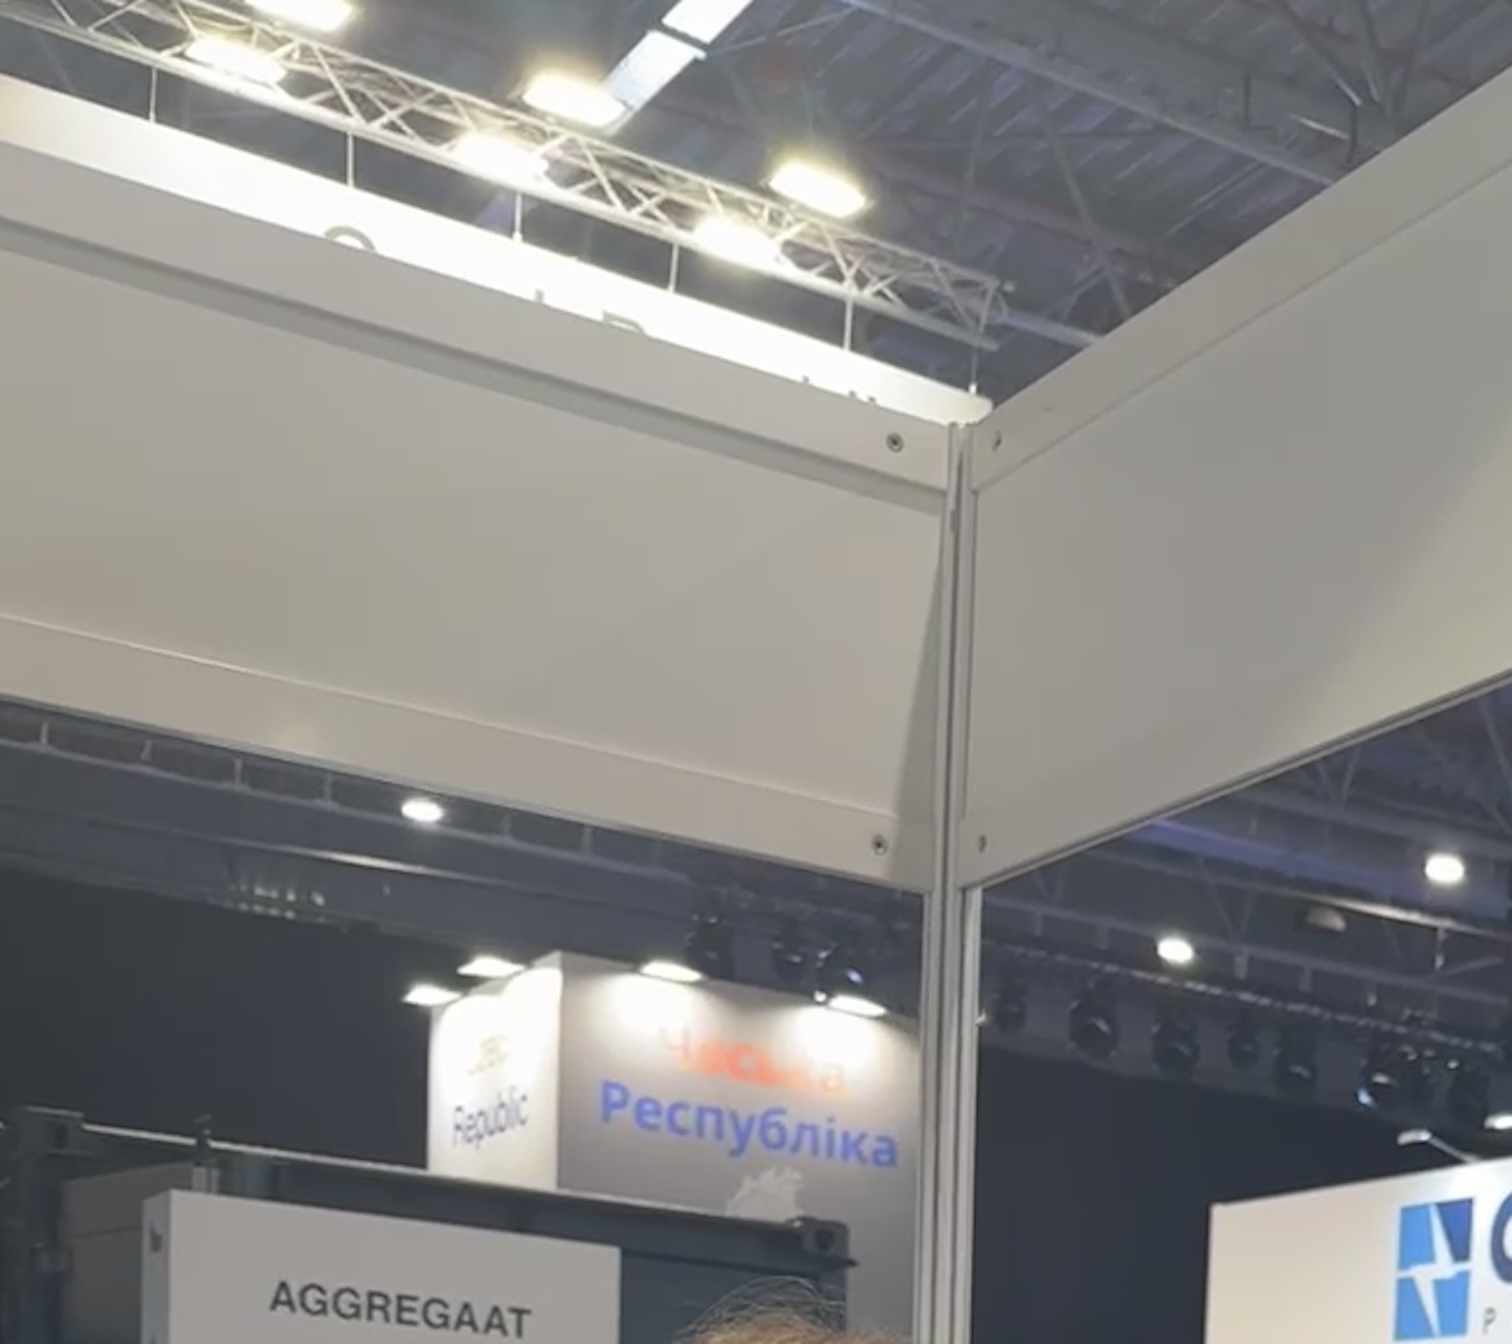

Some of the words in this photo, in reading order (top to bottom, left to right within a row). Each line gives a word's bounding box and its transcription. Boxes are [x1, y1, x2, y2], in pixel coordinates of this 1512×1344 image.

[453, 1082, 529, 1149] Republic
[600, 1080, 900, 1168] Республіка
[269, 1279, 532, 1340] AGGREGAAT
